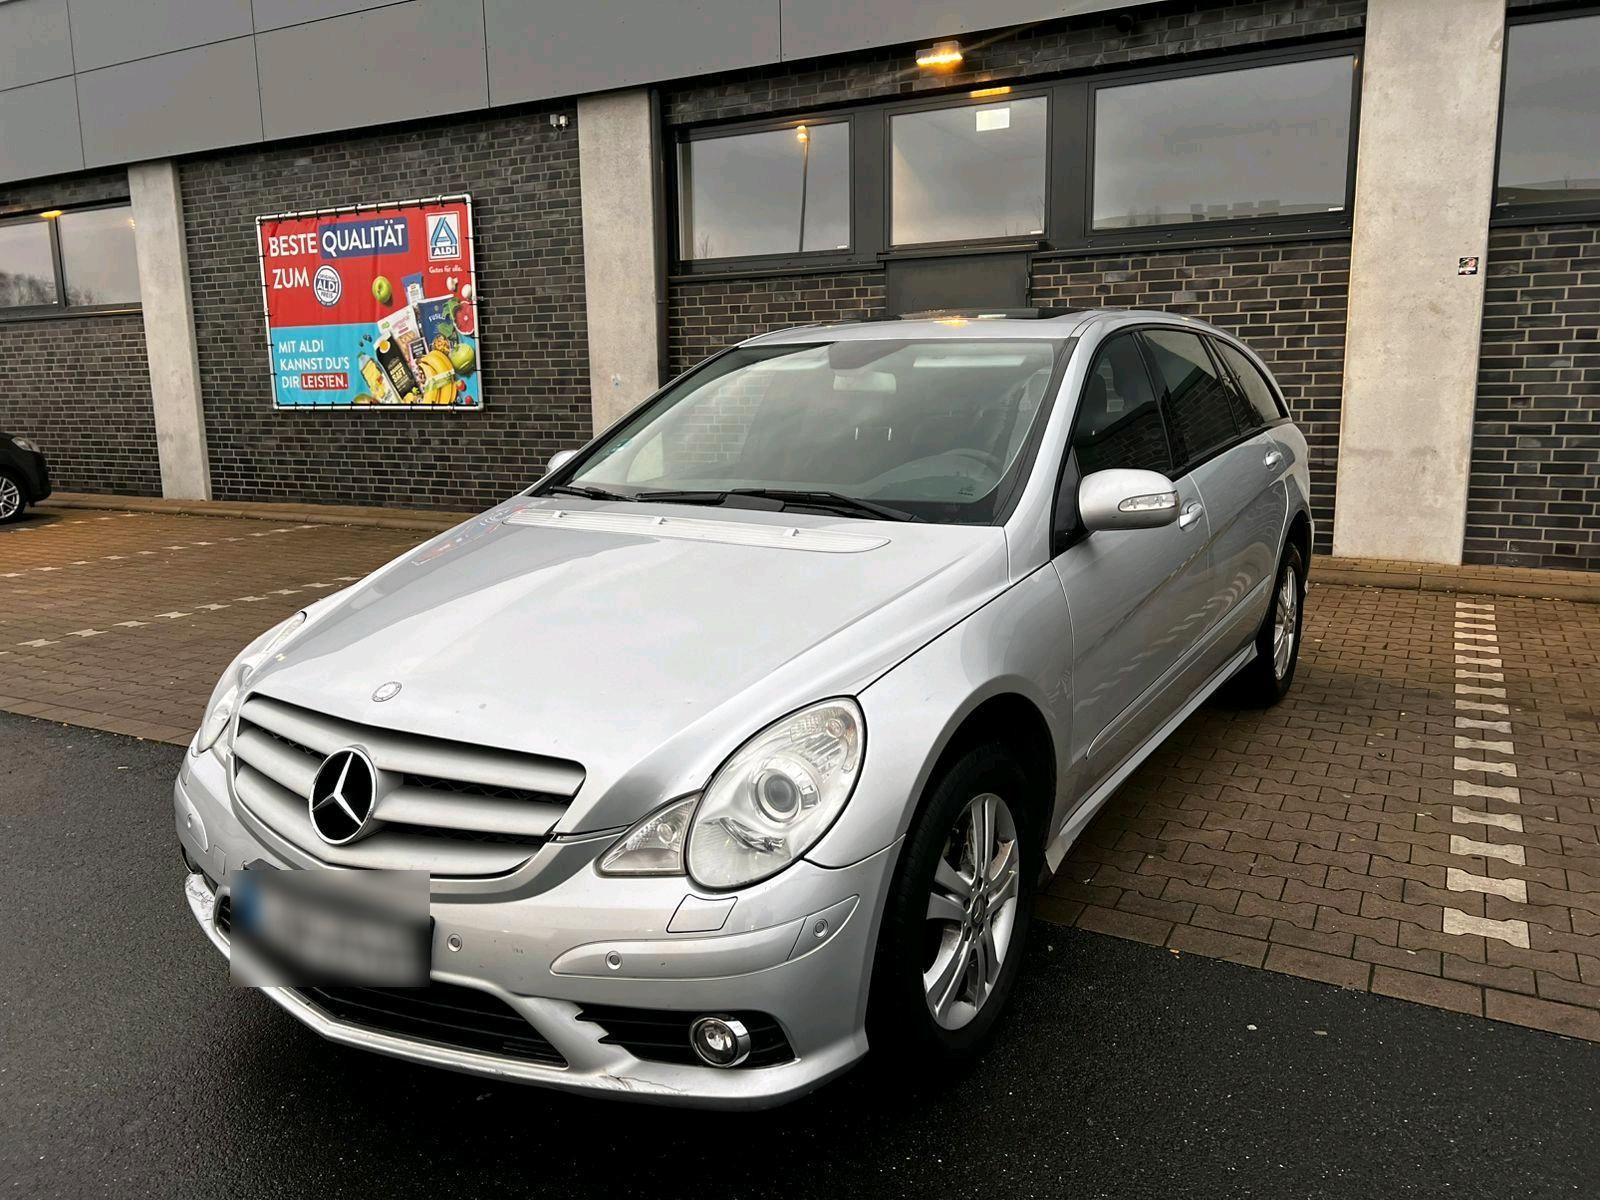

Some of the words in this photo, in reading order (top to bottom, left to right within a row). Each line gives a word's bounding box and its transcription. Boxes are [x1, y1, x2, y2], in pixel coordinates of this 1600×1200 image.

[268, 232, 318, 258] BESTE
[321, 220, 405, 258] QUALITÄT
[433, 246, 456, 256] ALDI
[272, 267, 310, 290] ZUM
[317, 279, 338, 293] ALDI
[278, 340, 296, 354] MIT
[299, 339, 324, 353] ALDI
[280, 358, 322, 371] KANNST
[326, 357, 350, 370] DU'S
[282, 376, 300, 389] DIR
[302, 374, 348, 388] LEISTEN.
